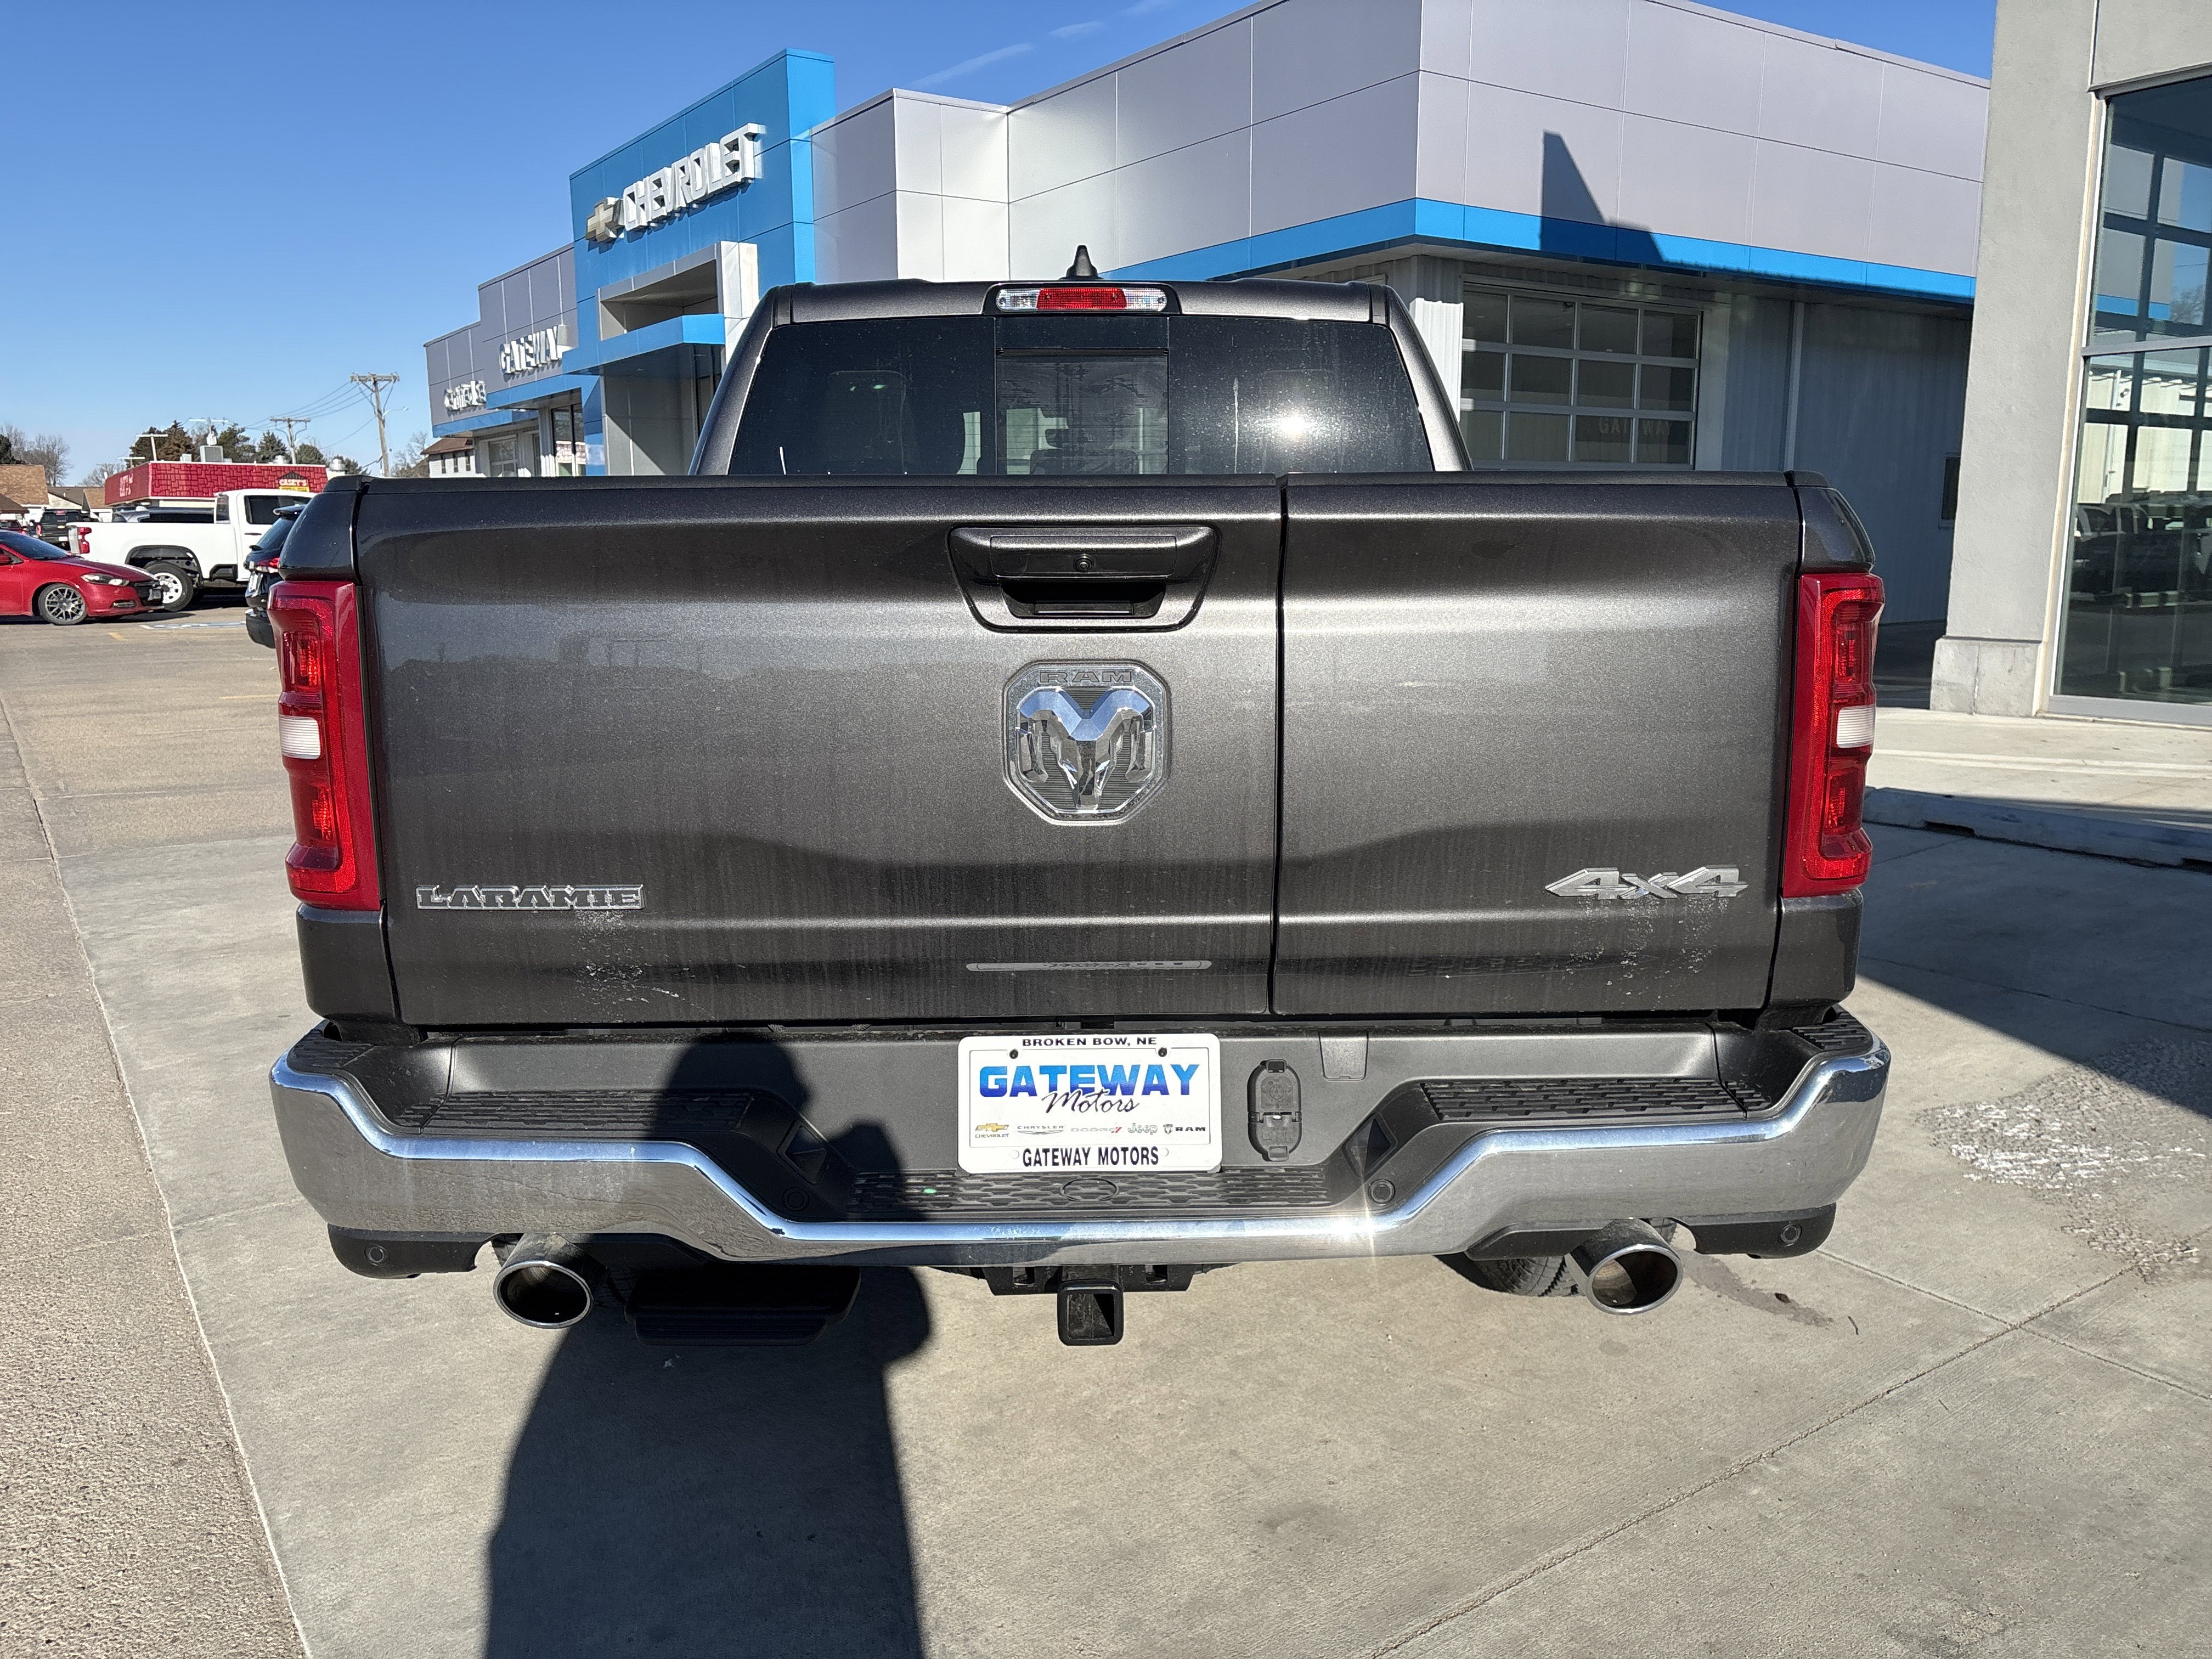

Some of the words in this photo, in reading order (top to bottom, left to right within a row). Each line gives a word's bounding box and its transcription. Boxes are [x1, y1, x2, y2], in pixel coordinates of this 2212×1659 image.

[623, 123, 766, 231] CHEVROLET
[1039, 671, 1132, 683] RAM
[415, 885, 644, 910] LARAMIE
[1022, 1038, 1087, 1046] BROKEN
[1092, 1037, 1131, 1047] BOW,
[1137, 1037, 1157, 1045] NE
[979, 1064, 1200, 1097] GATEWAY
[1041, 1088, 1140, 1114] Motors
[1127, 1122, 1158, 1135] Jeep
[1023, 1148, 1092, 1167] GATEWAY
[1098, 1147, 1159, 1166] MOTORS
